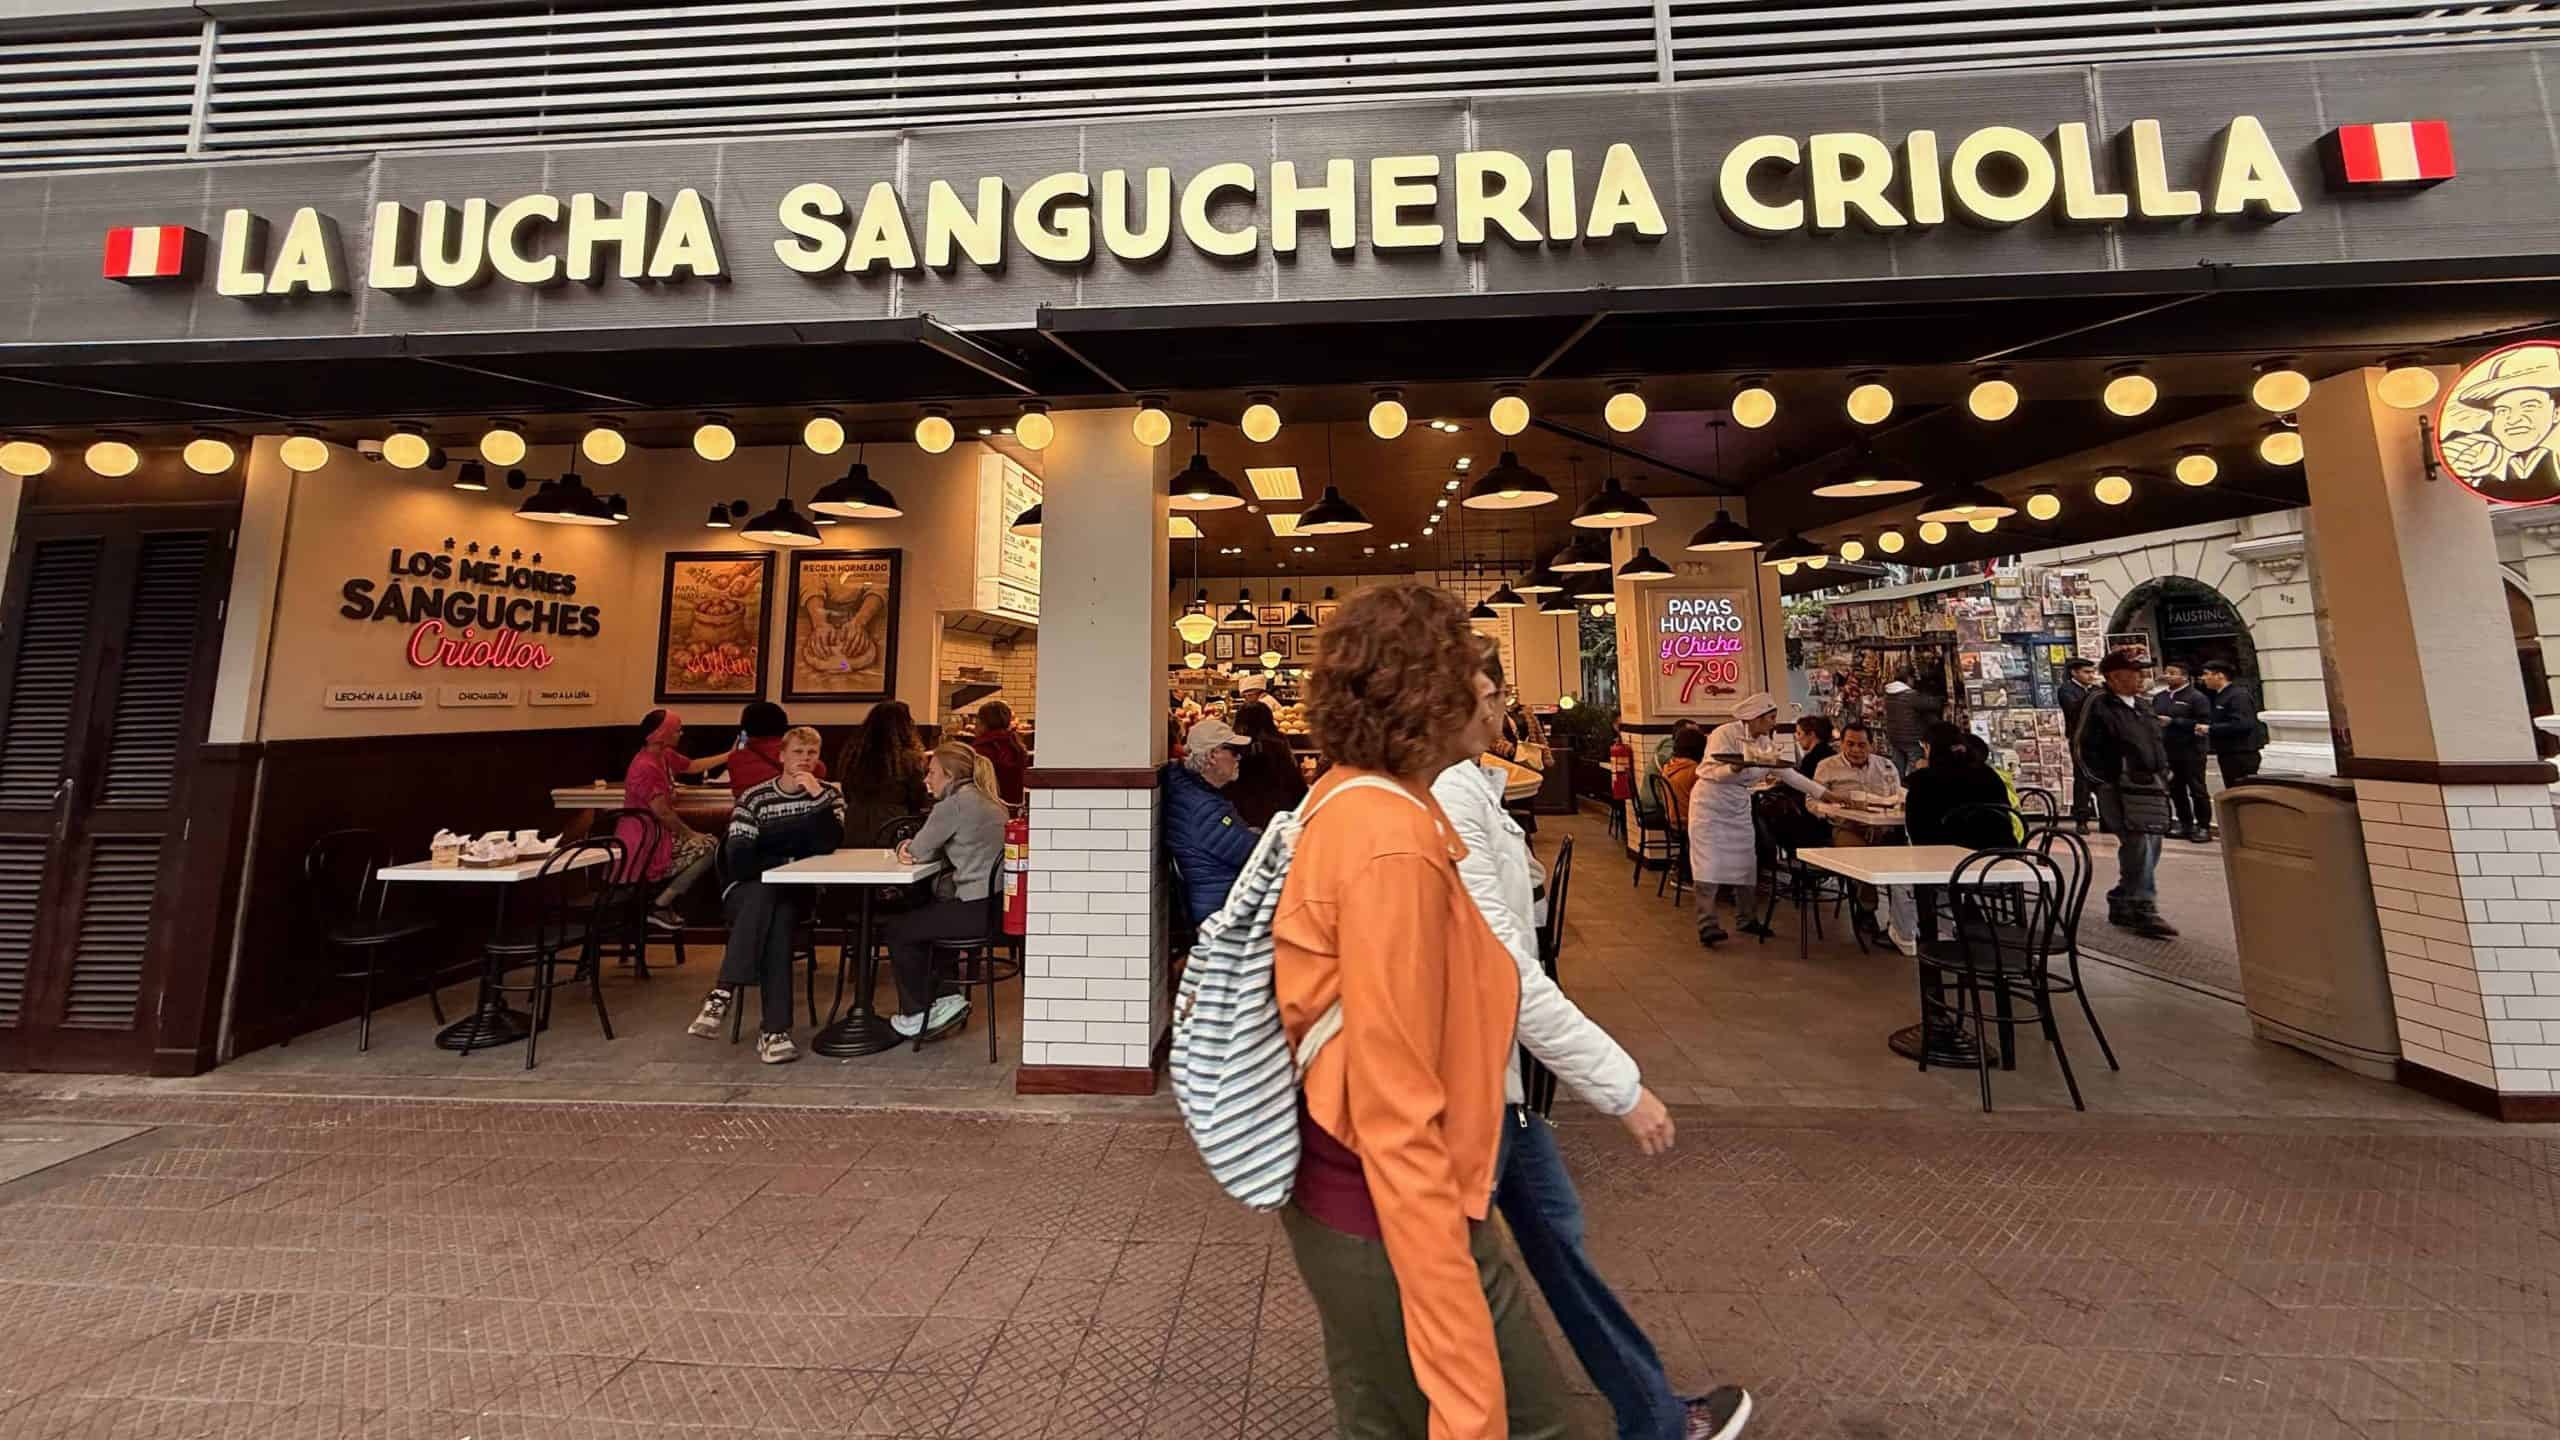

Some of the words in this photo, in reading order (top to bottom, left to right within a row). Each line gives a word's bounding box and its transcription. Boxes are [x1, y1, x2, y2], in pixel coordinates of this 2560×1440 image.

[217, 207, 333, 297] LA
[368, 188, 721, 289] LUCHA
[773, 142, 1668, 274] SANGUCHERIA
[1719, 115, 2302, 231] CRIOLLA
[389, 548, 453, 580] LOS
[459, 558, 577, 596] MEJORES
[838, 563, 888, 572] HORNEADO
[341, 577, 601, 637] SÁNGUCHES
[1668, 599, 1733, 616] PAPAS
[1660, 616, 1742, 633] HUAYRO
[408, 619, 553, 670] Criollos
[1675, 635, 1743, 658] Chicha
[376, 692, 384, 701] A
[386, 692, 398, 701] LA
[399, 690, 423, 701] LEÑA
[1677, 659, 1739, 704] 7.90
